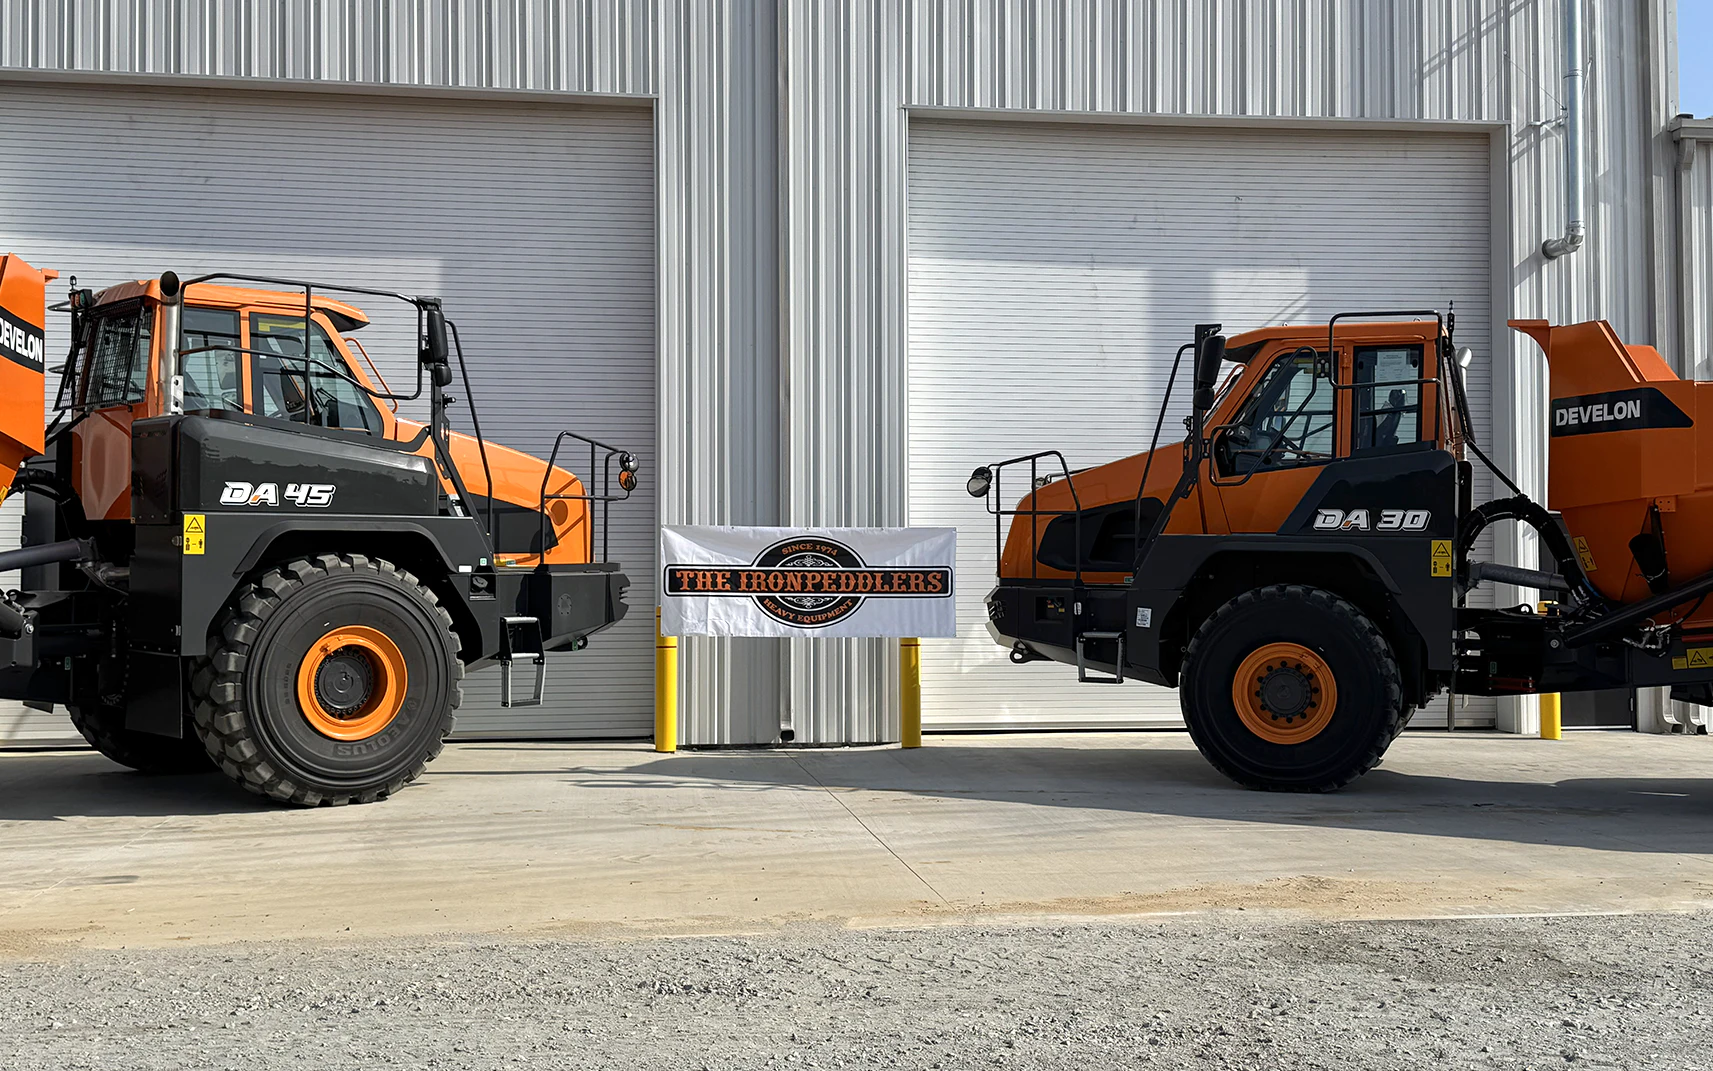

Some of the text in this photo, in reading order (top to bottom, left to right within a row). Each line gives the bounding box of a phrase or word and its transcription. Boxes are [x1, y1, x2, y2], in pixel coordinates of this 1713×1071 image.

[1555, 400, 1641, 426] DEVELON
[220, 481, 337, 508] DA 45
[1313, 509, 1432, 532] DA 30
[781, 543, 838, 556] SINCE 1974
[675, 570, 943, 592] THE IRONPEDDLERS
[763, 598, 853, 623] HEAVY EQUIPMENT
